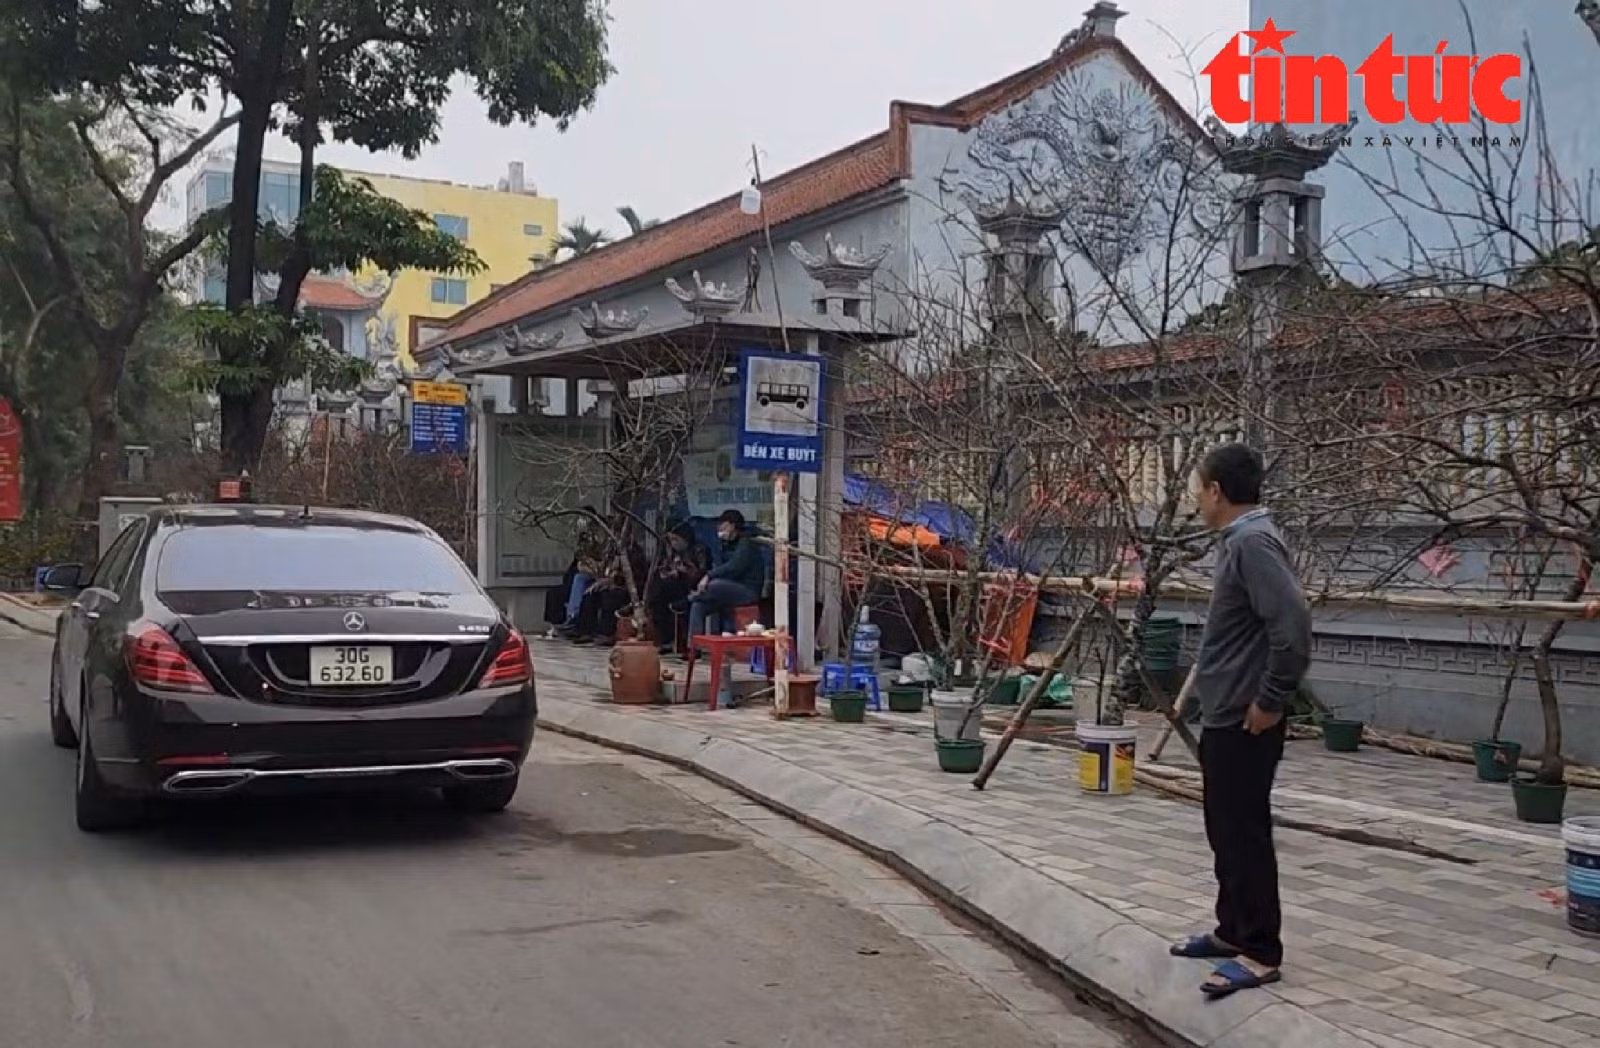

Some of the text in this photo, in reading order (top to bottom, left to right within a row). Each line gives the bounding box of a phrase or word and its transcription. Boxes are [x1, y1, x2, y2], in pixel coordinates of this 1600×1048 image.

[769, 446, 785, 460] XE
[335, 647, 370, 664] 30G
[319, 665, 385, 682] 632.60
